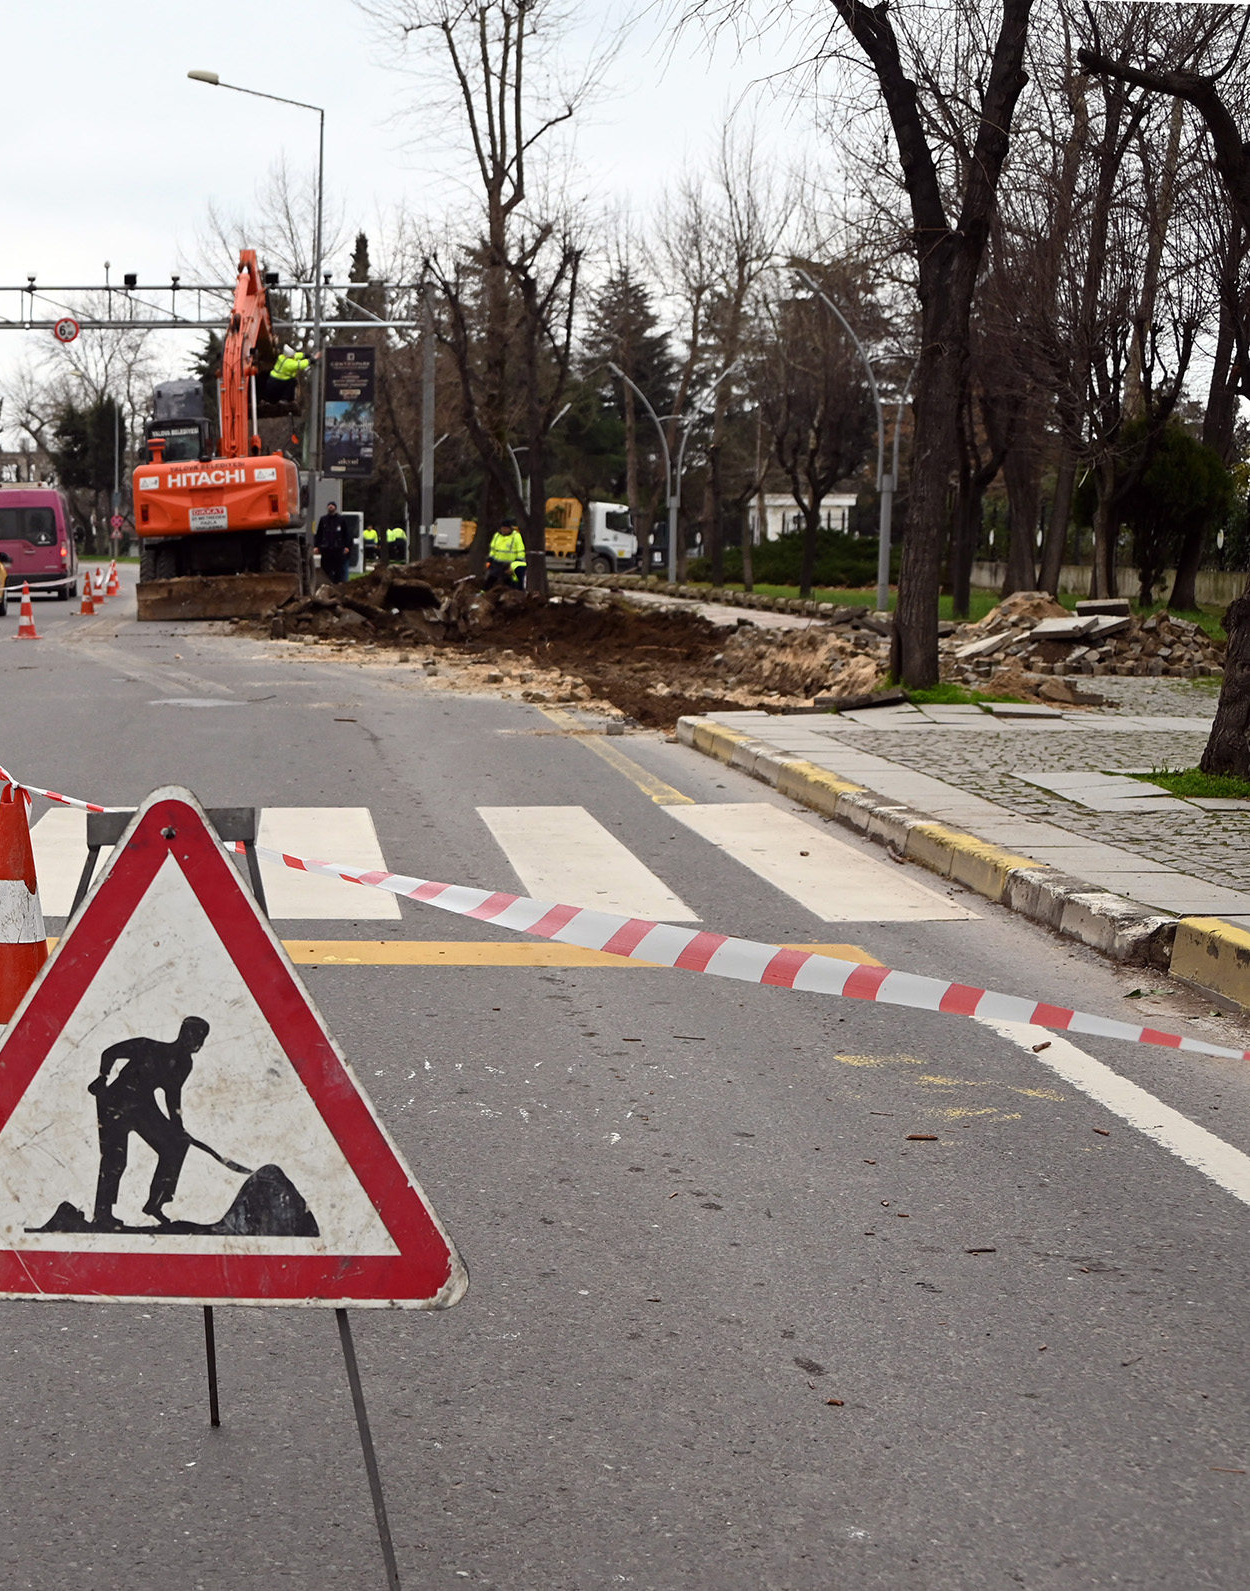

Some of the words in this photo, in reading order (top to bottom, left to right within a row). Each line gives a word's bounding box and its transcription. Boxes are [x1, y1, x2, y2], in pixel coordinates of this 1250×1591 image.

[152, 429, 171, 437] YALOVA
[170, 464, 199, 473] YALOVA
[167, 469, 246, 489] HITACHI
